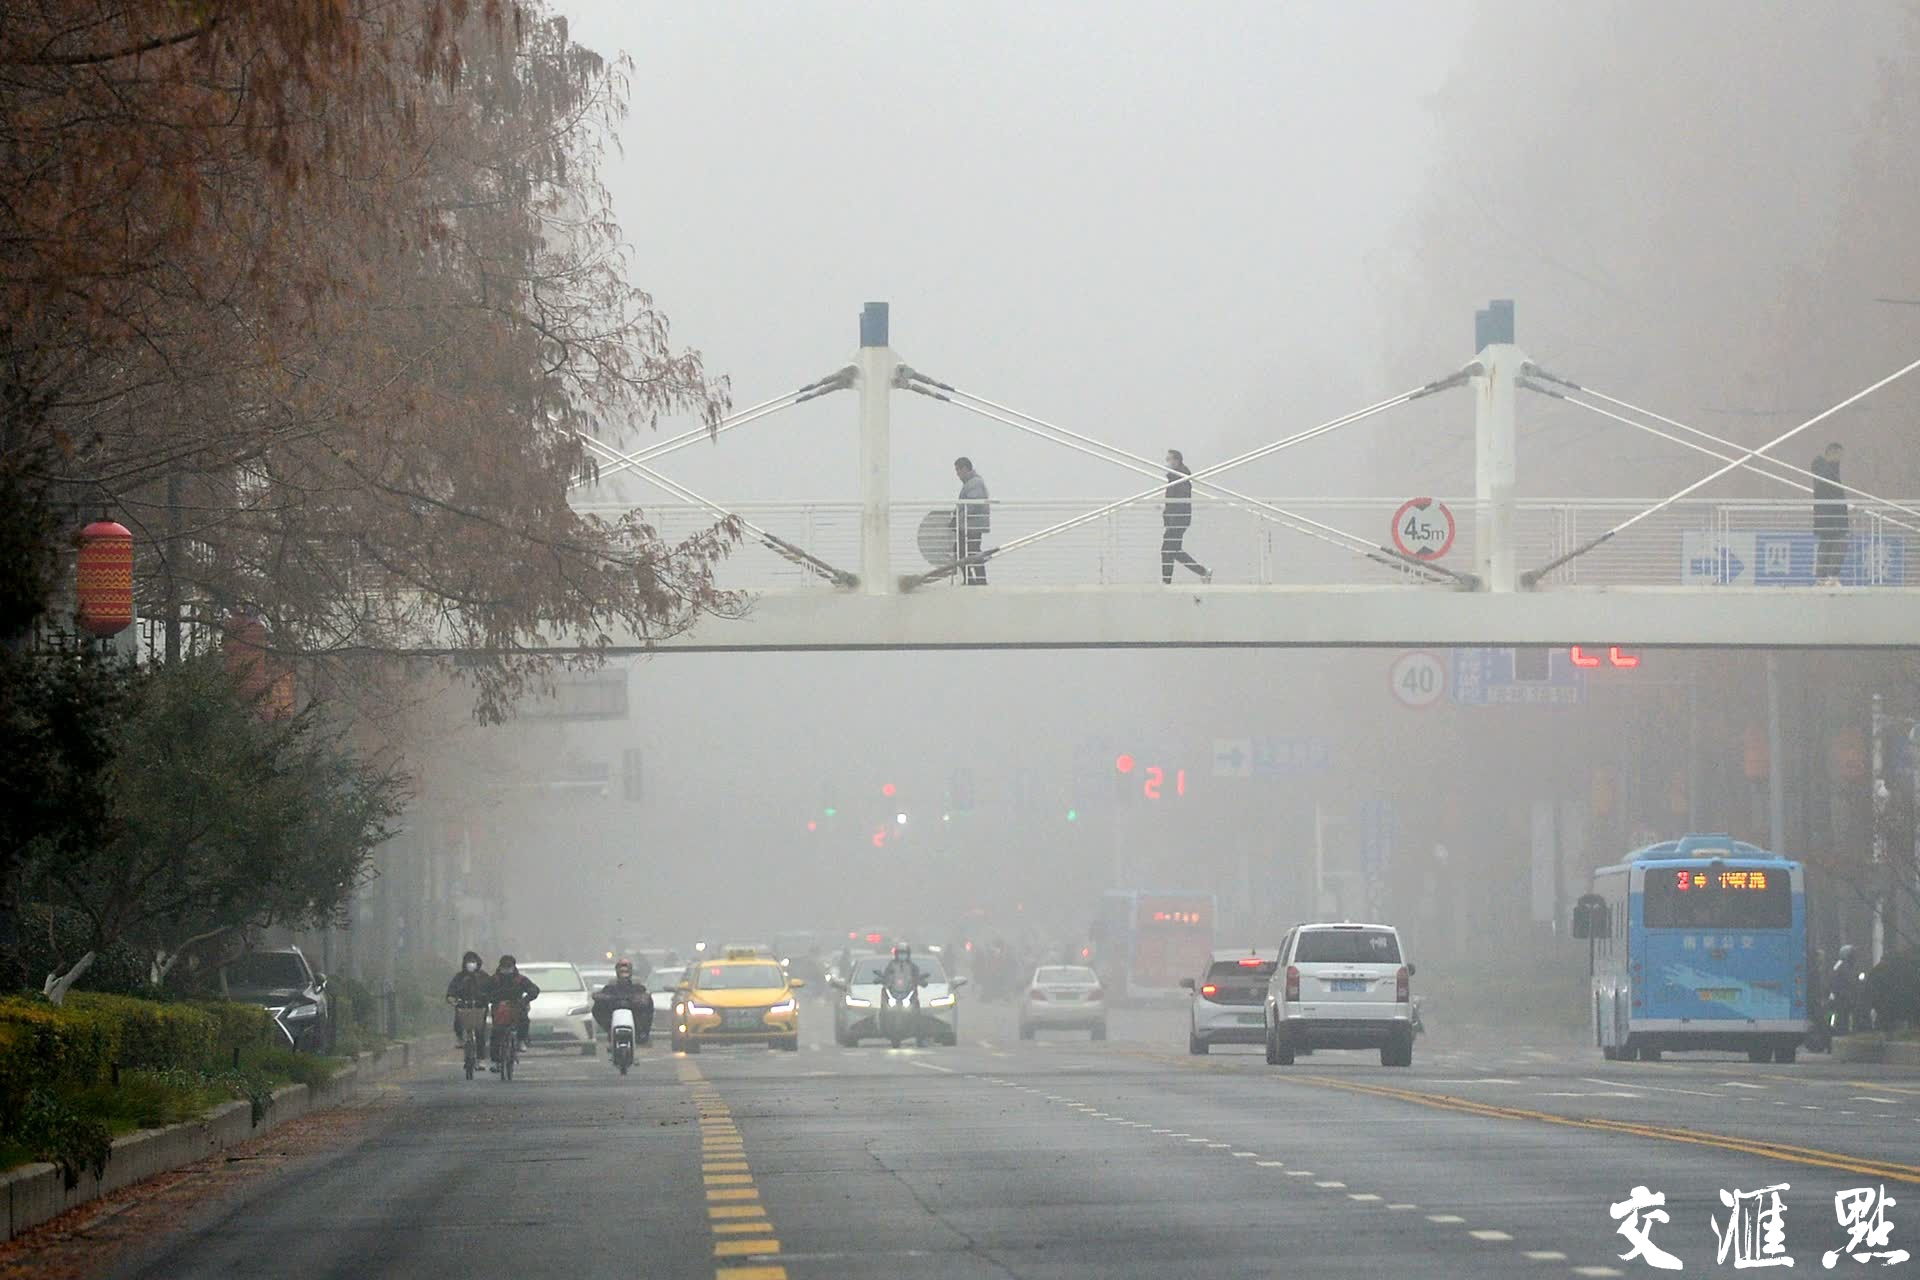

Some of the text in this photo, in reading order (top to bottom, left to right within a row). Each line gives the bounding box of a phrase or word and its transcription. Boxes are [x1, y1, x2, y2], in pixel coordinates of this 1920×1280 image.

[1404, 516, 1445, 541] 4.5m
[1401, 666, 1433, 693] 40
[1144, 766, 1185, 800] 21
